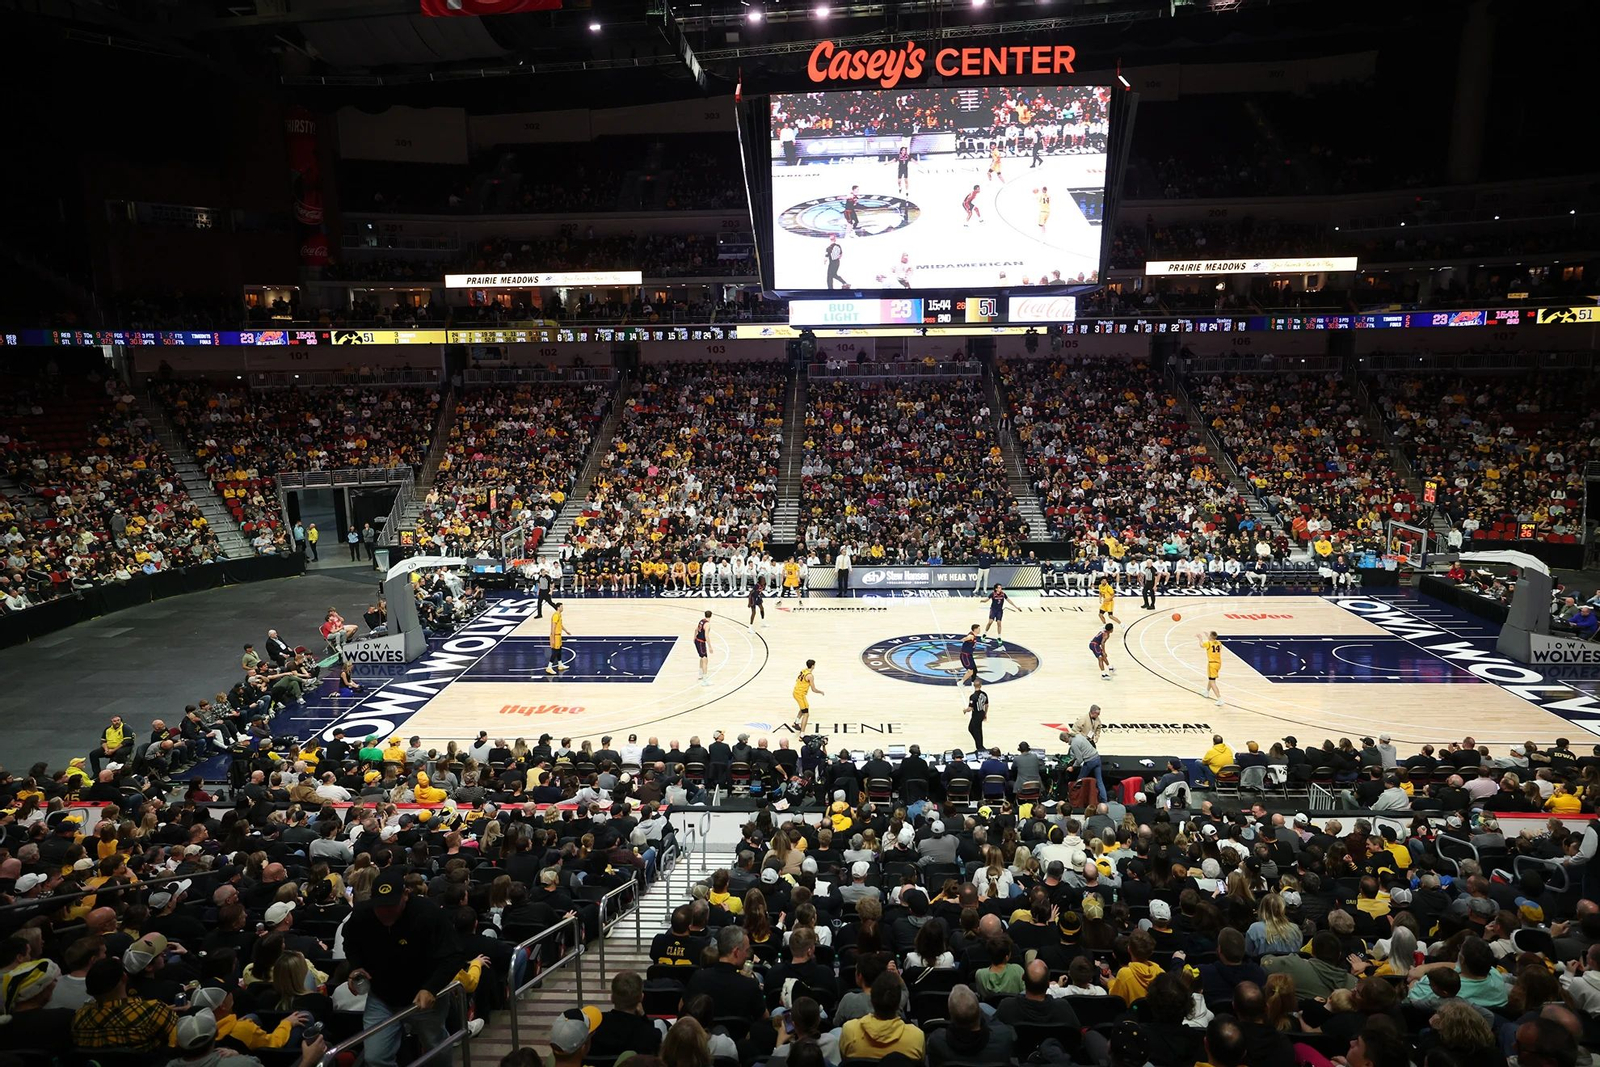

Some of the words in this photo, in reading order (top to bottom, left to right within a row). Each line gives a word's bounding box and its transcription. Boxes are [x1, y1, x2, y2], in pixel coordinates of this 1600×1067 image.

[807, 40, 927, 89] Casey's
[935, 46, 1076, 77] CENTER
[704, 112, 719, 120] 303
[916, 261, 1024, 270] MIDAMERICAN
[1167, 263, 1203, 272] PRAIRIE
[1204, 262, 1247, 270] MEADOWS
[466, 277, 498, 285] PRAIRIE
[500, 276, 540, 284] MEADOWS
[829, 303, 855, 312] BUD
[889, 301, 912, 320] 23
[928, 299, 951, 310] 15:44
[979, 298, 998, 317] 51
[824, 312, 860, 322] LIGHT
[1432, 313, 1448, 325] 23
[1578, 311, 1593, 322] 51
[1171, 324, 1180, 332] 22
[1209, 323, 1217, 331] 24
[240, 332, 255, 344] 23
[363, 332, 375, 343] 51
[629, 332, 637, 341] 14
[667, 332, 676, 341] 15
[1231, 337, 1250, 346] 106
[1493, 332, 1515, 341] 107
[538, 348, 557, 357] 102
[705, 345, 724, 354] 103
[835, 344, 854, 352] 104
[289, 352, 308, 360] 101
[1423, 489, 1436, 504] 26
[1520, 530, 1532, 538] 26
[904, 570, 930, 581] Hansen
[937, 573, 948, 581] WE
[949, 573, 967, 581] HEAR
[967, 574, 978, 582] YO
[1320, 595, 1448, 641] IOWA
[356, 643, 390, 652] IOWA
[1212, 645, 1221, 653] 14
[1547, 642, 1586, 650] IOWA
[345, 650, 404, 663] WOLVES
[1533, 650, 1600, 663] WOLVES
[321, 675, 459, 745] OWA
[404, 598, 539, 675] WOLVES
[1553, 752, 1577, 762] IOWA
[666, 945, 686, 957] CLARK
